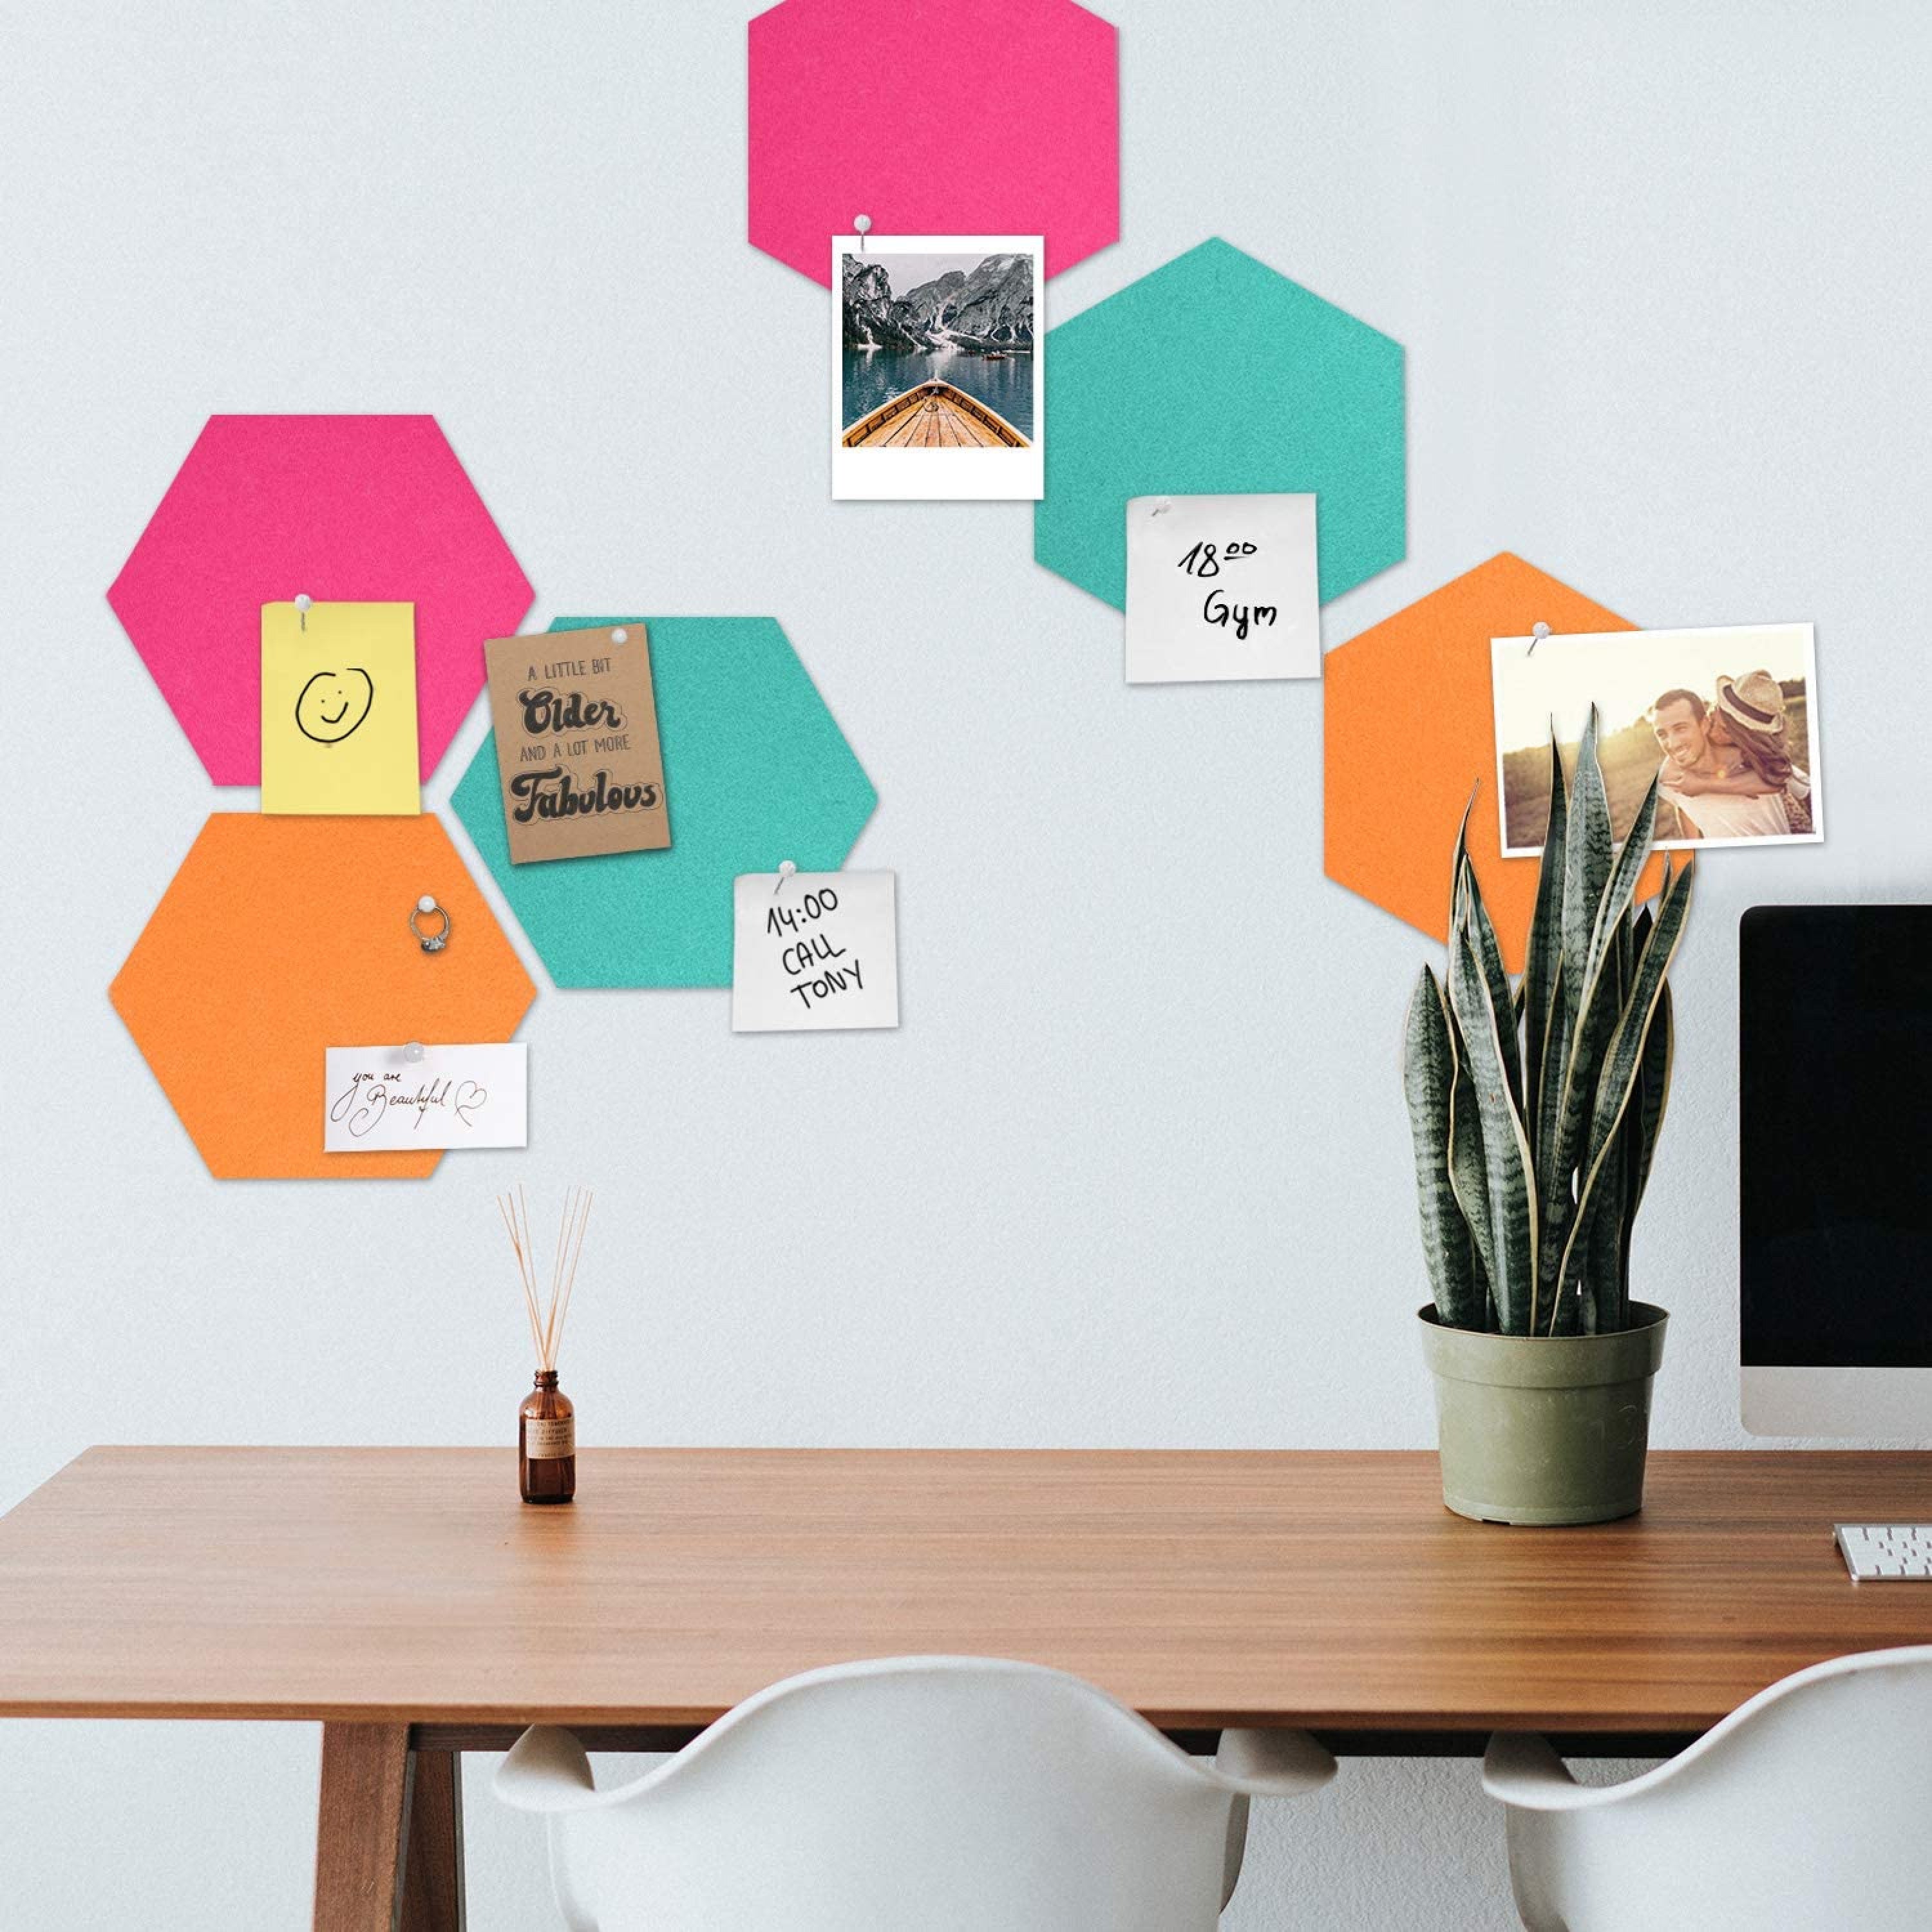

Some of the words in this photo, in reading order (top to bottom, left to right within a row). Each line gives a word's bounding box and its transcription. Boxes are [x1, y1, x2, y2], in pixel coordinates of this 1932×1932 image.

[1204, 589, 1277, 640] Gym
[529, 666, 537, 681] A
[544, 660, 585, 679] LITTLE
[592, 658, 611, 674] BIT
[518, 690, 621, 734] Older
[520, 746, 545, 761] AND
[554, 743, 562, 758] A
[567, 741, 587, 757] LOT
[594, 734, 631, 752] MORE
[511, 766, 657, 822] Fabulous
[767, 888, 838, 937] 14:00
[782, 934, 847, 976] CALL
[790, 959, 864, 1009] TONY
[331, 1073, 374, 1122] you
[383, 1073, 401, 1082] are
[349, 1078, 452, 1137] Beautiful
